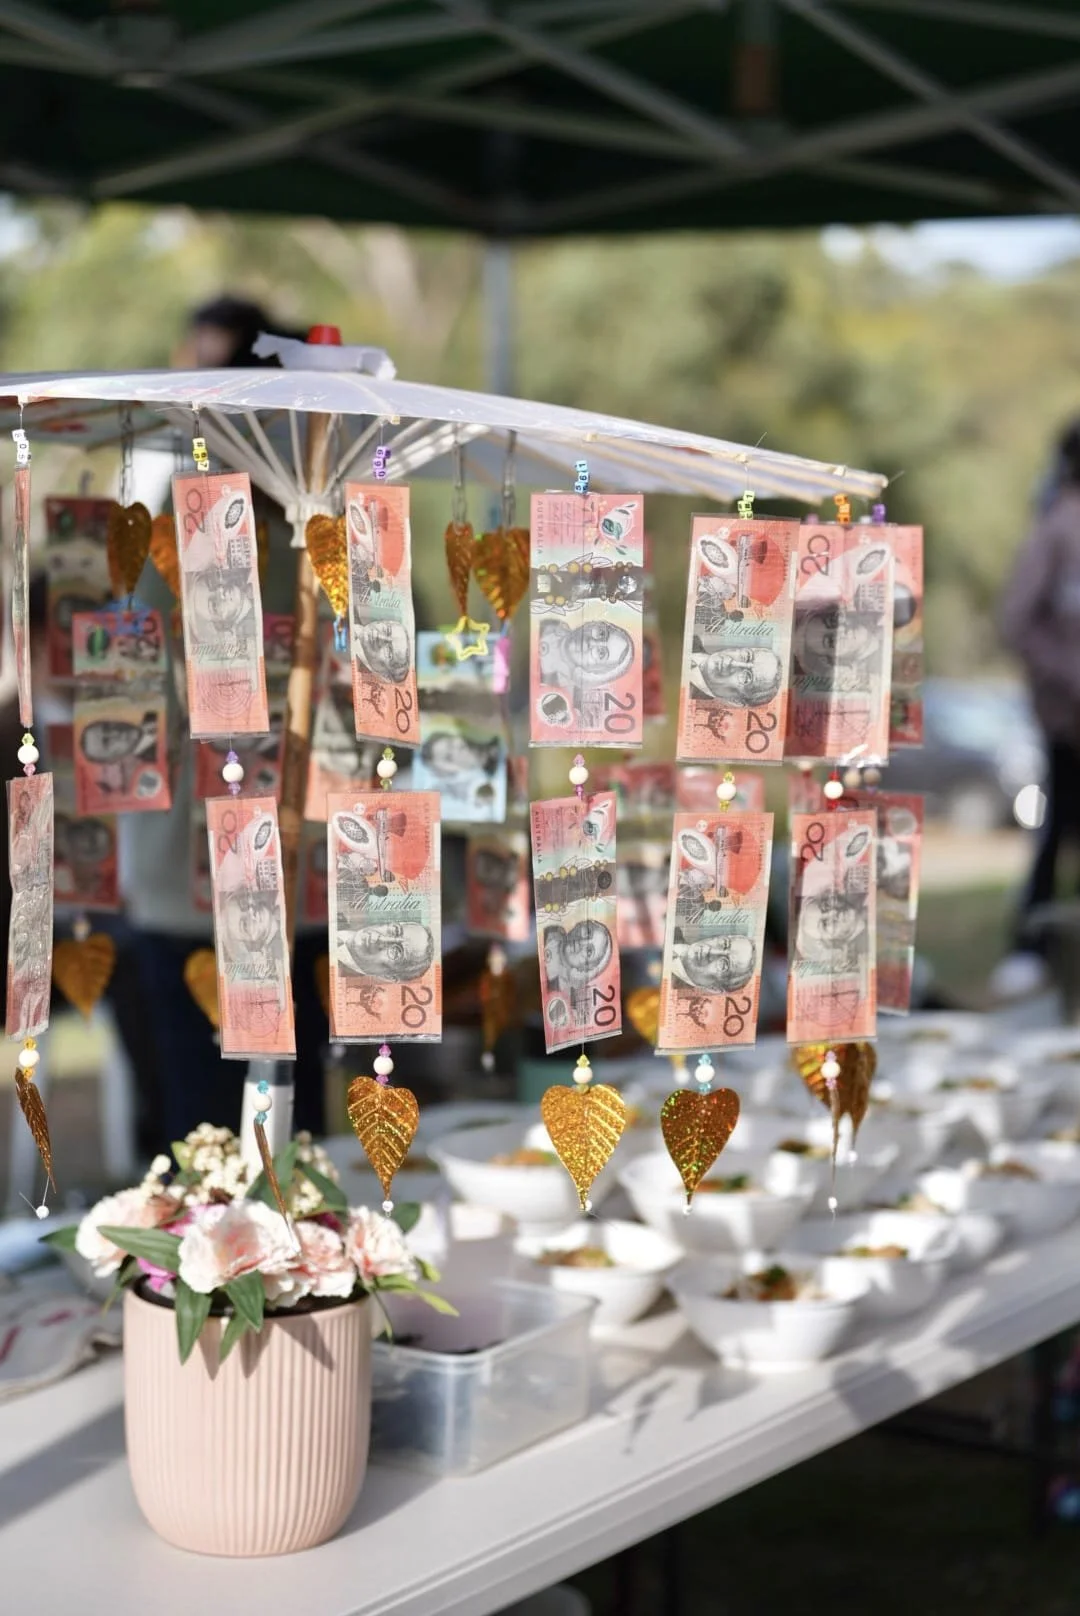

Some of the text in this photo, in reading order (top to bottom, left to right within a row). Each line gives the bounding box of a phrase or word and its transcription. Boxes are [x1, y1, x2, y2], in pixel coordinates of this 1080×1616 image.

[184, 488, 205, 533] 20
[536, 500, 544, 554] AUSTRALIA
[395, 687, 413, 734] 20
[604, 692, 636, 734] 20
[745, 710, 777, 754] 20
[218, 809, 238, 854] 20
[535, 811, 543, 864] AUSTRALIA
[800, 822, 825, 861] 20
[401, 985, 433, 1029] 20
[593, 984, 617, 1027] 20
[723, 996, 752, 1037] 20
